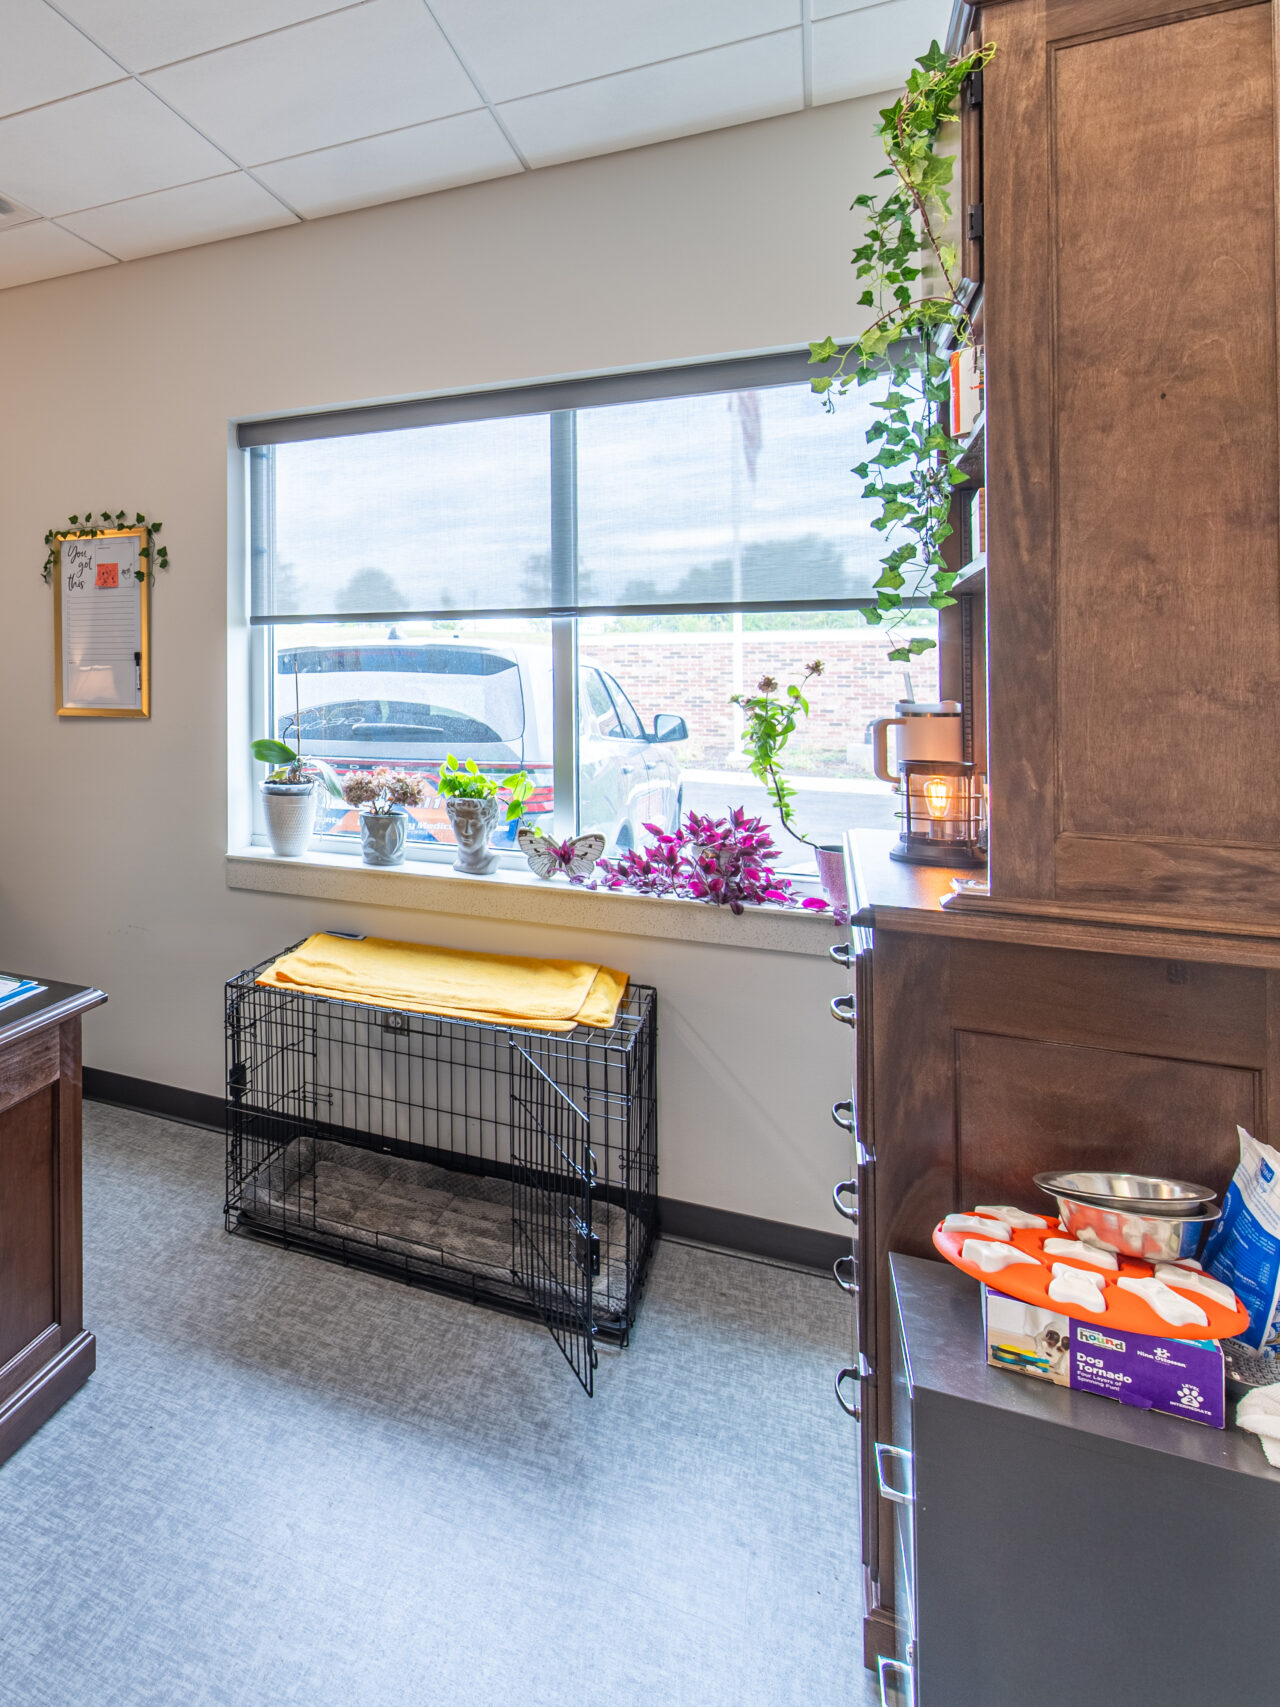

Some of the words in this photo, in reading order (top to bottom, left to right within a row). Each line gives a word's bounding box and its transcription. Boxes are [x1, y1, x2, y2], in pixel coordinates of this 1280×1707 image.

[67, 545, 87, 564] You
[77, 556, 93, 578] got
[67, 573, 85, 592] this
[1079, 1331, 1124, 1351] hound
[1076, 1352, 1104, 1368] Dog
[1076, 1361, 1133, 1383] Tornado
[1077, 1370, 1092, 1378] Four
[1092, 1375, 1114, 1385] Layers
[1077, 1375, 1105, 1388] Spinning
[1105, 1383, 1120, 1391] Fun!
[1181, 1383, 1200, 1393] LEVEL
[1169, 1400, 1213, 1416] INTERMEDIATE
